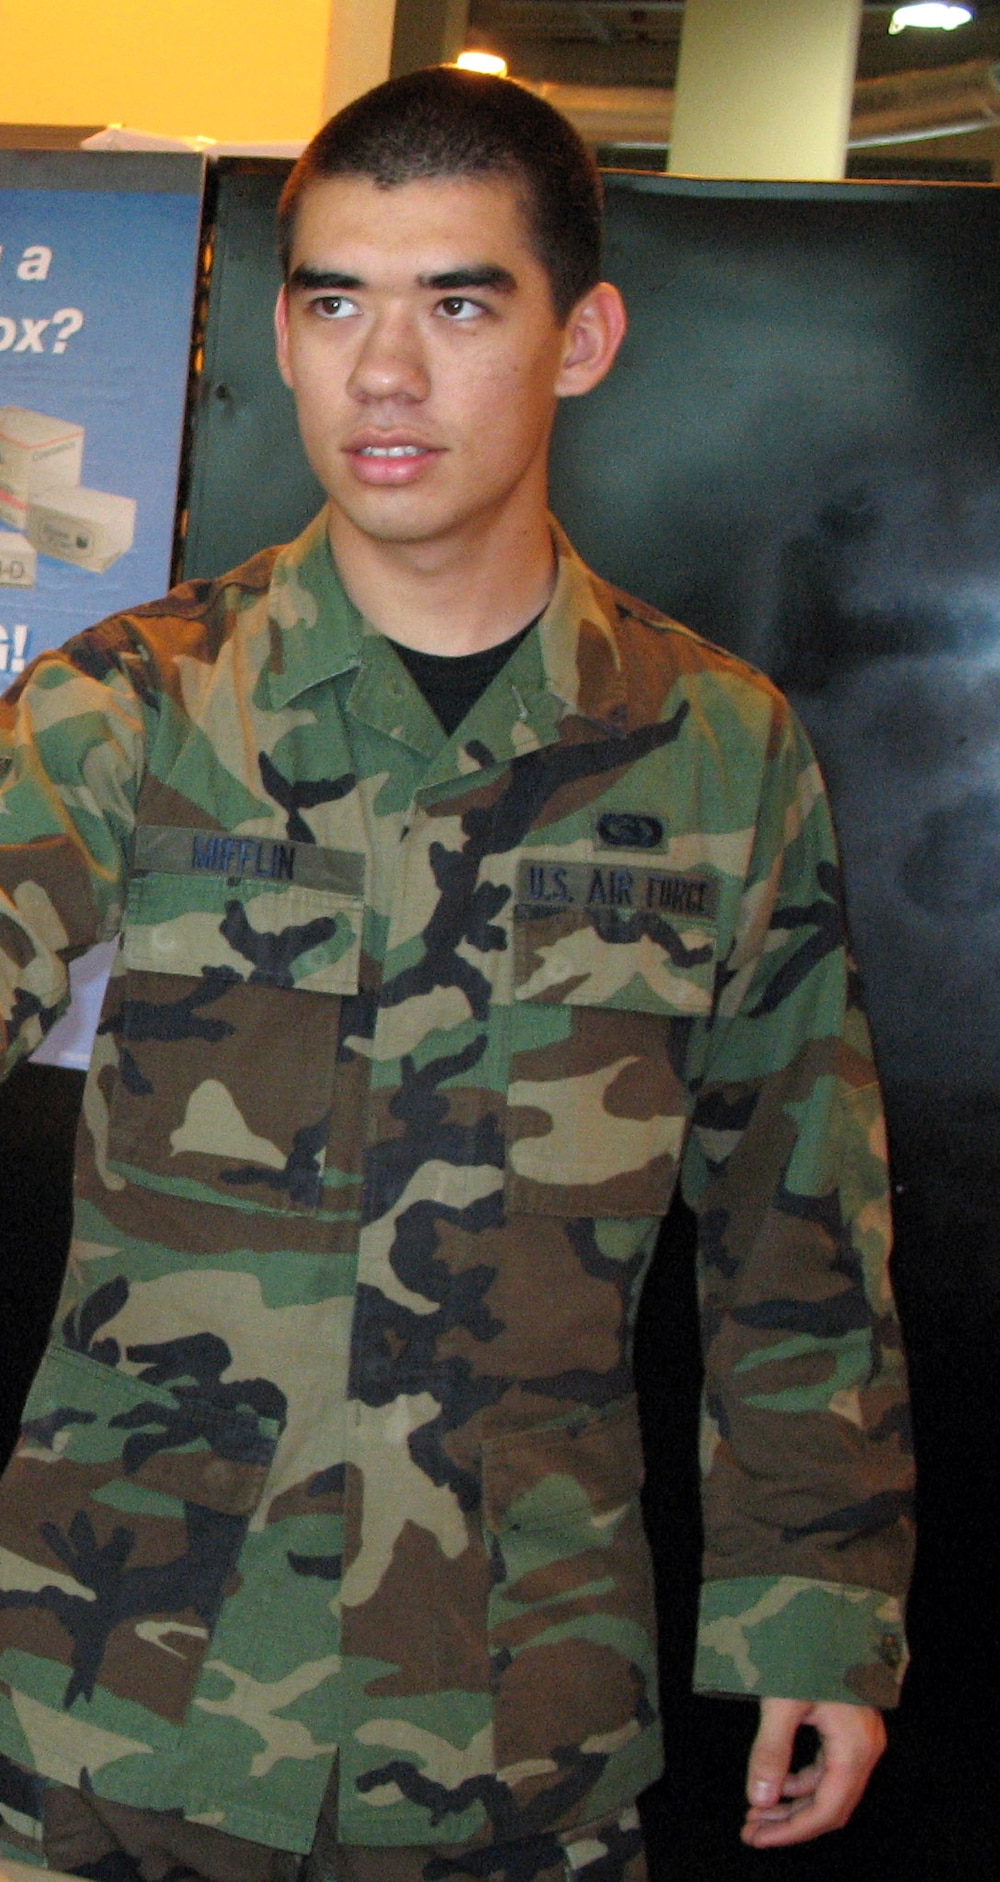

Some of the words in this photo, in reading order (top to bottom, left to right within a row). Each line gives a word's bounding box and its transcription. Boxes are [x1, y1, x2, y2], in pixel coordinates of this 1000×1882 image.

[17, 245, 53, 281] a
[192, 835, 296, 880] MIFFLIN
[527, 866, 575, 903] U.S.
[588, 869, 634, 906] AIR
